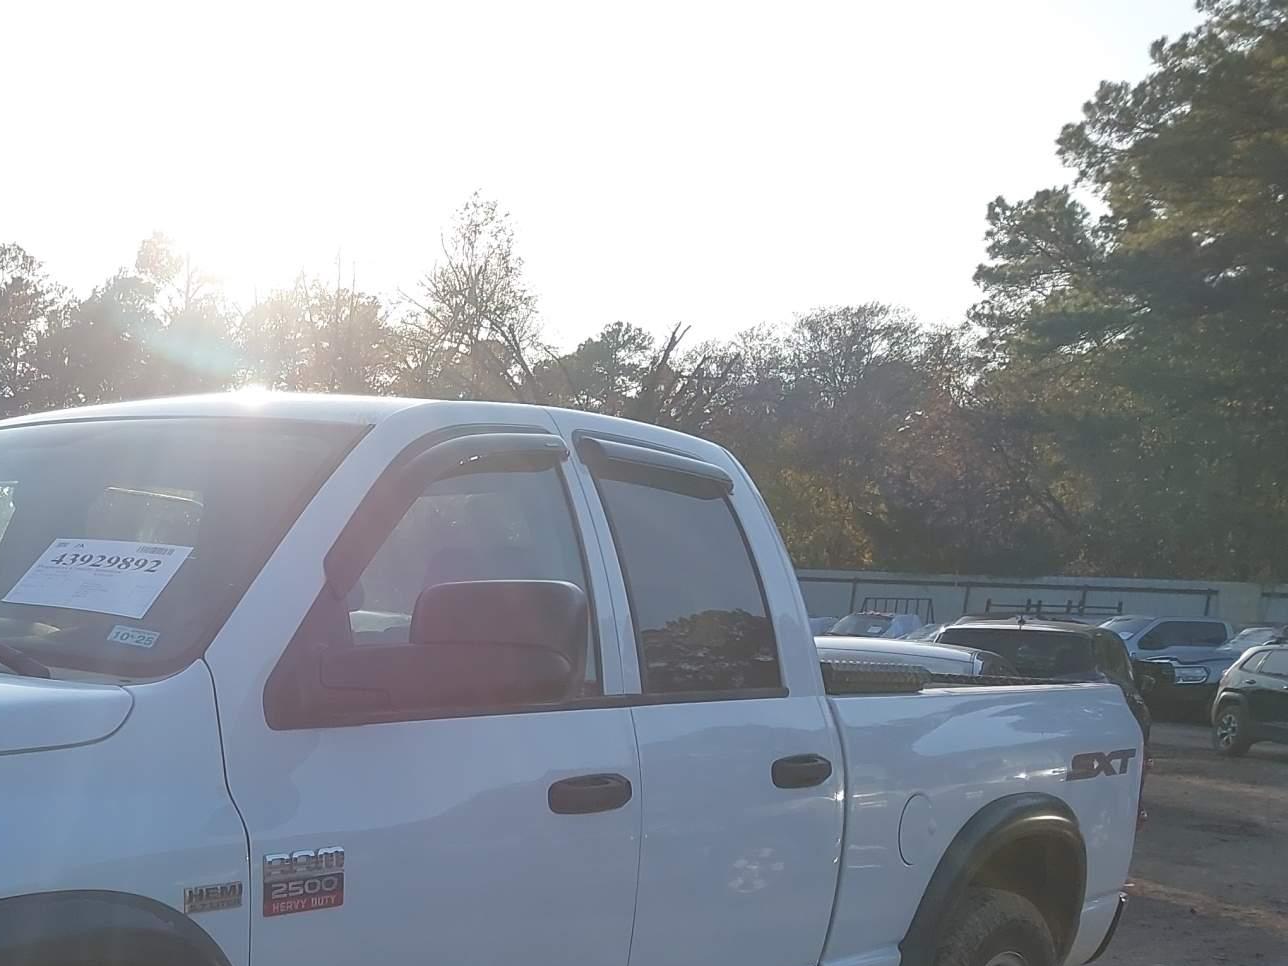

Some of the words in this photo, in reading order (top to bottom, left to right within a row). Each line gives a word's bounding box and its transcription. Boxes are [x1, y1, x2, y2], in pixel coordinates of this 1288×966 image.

[50, 551, 163, 573] 43929892
[1065, 748, 1137, 782] SXT
[271, 876, 339, 900] 2500
[272, 898, 308, 913] HEAVY
[311, 893, 337, 906] DUTY
